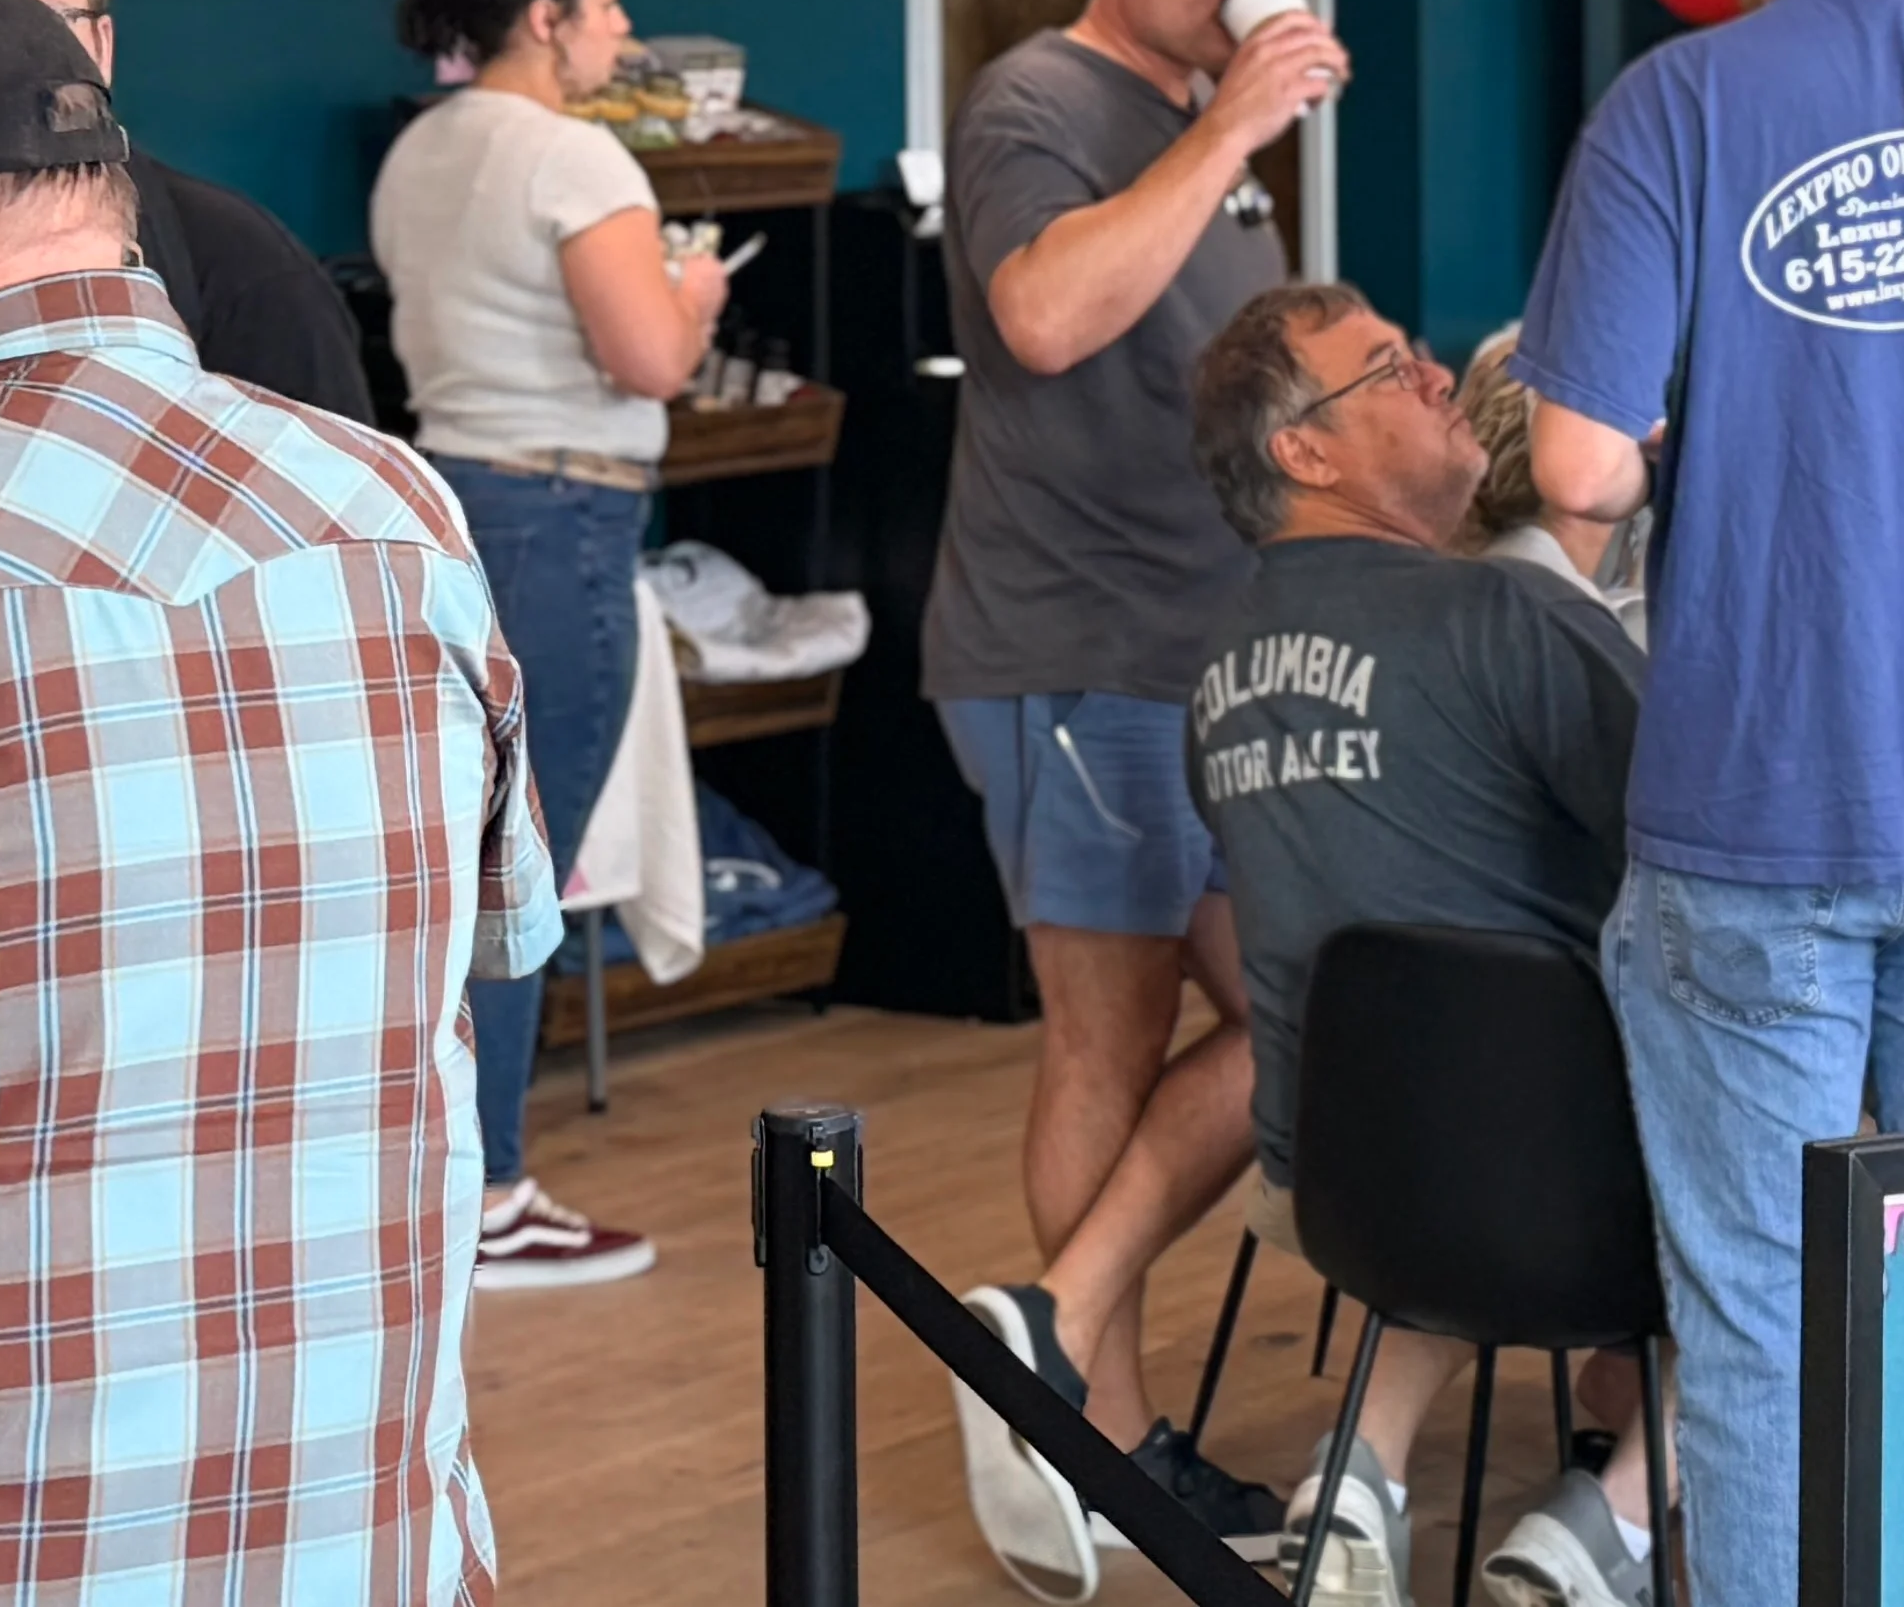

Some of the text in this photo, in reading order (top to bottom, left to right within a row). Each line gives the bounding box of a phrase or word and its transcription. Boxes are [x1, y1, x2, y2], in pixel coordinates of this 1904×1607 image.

[1764, 154, 1874, 251] LEXPRO
[1816, 219, 1902, 248] Lexus
[1192, 633, 1376, 742] COLUMBIA
